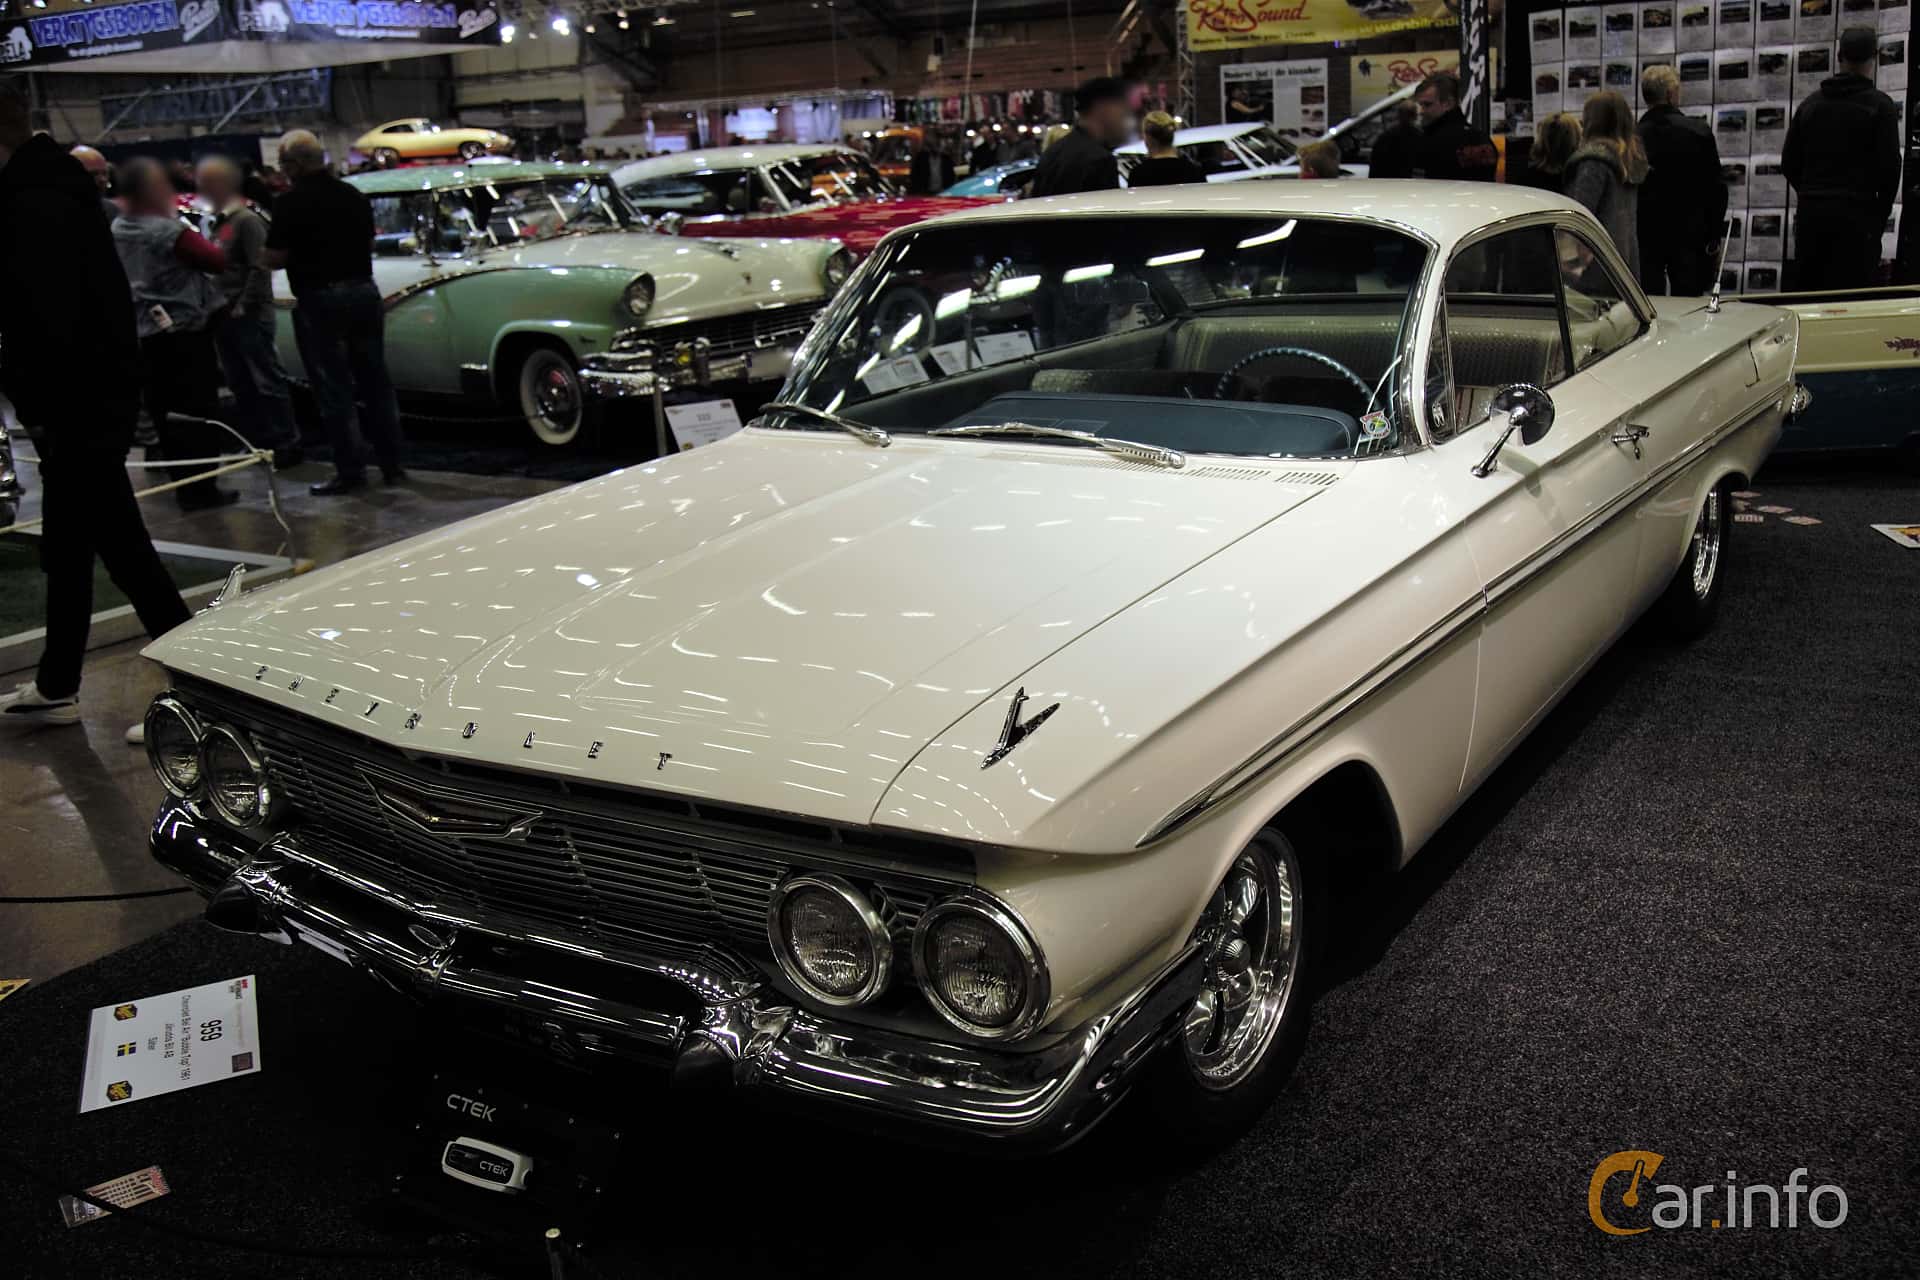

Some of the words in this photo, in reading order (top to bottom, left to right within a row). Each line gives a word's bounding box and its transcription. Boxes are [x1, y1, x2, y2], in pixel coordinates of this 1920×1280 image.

[200, 1019, 223, 1042] 959
[446, 1094, 497, 1122] CTEK
[479, 1160, 509, 1177] CTEK
